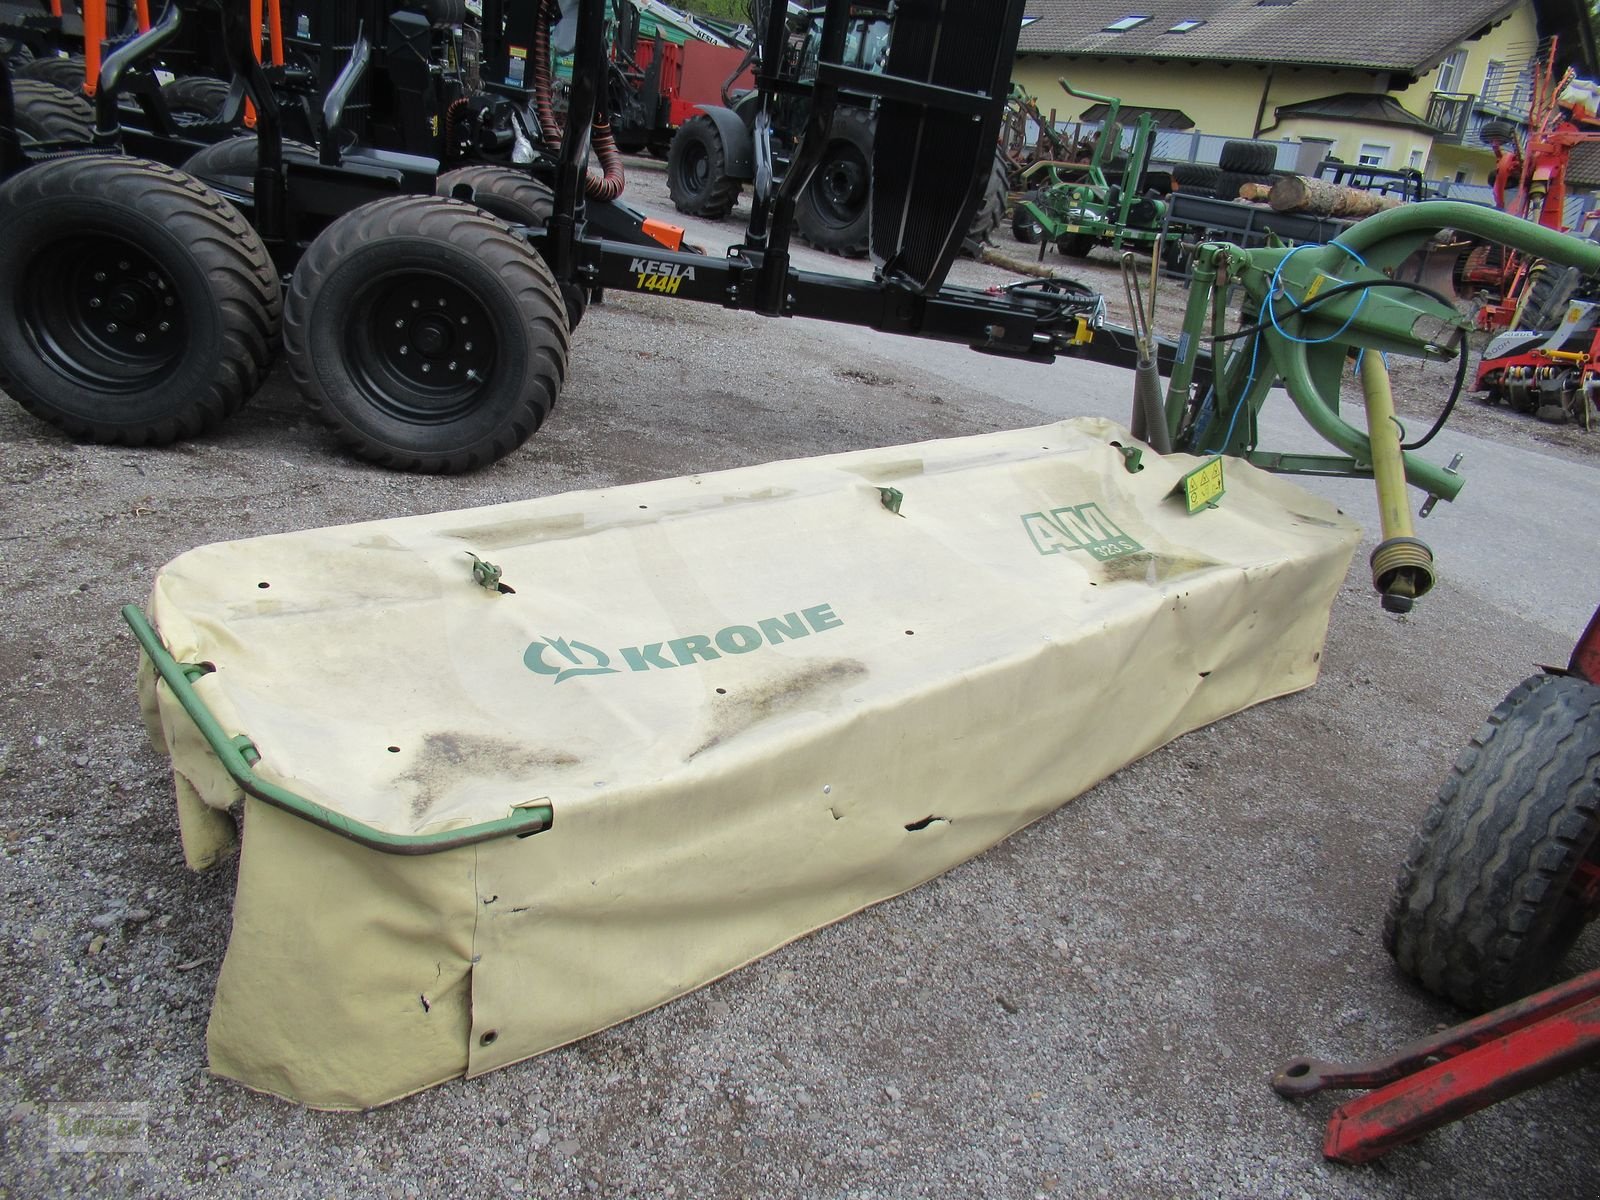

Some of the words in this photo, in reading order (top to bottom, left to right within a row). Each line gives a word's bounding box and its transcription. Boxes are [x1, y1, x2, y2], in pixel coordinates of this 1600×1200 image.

[696, 30, 718, 46] KESLA
[629, 258, 695, 281] KESLA
[637, 272, 681, 295] 144H
[1094, 543, 1122, 557] 323
[1119, 540, 1134, 550] S
[619, 603, 844, 672] KRONE
